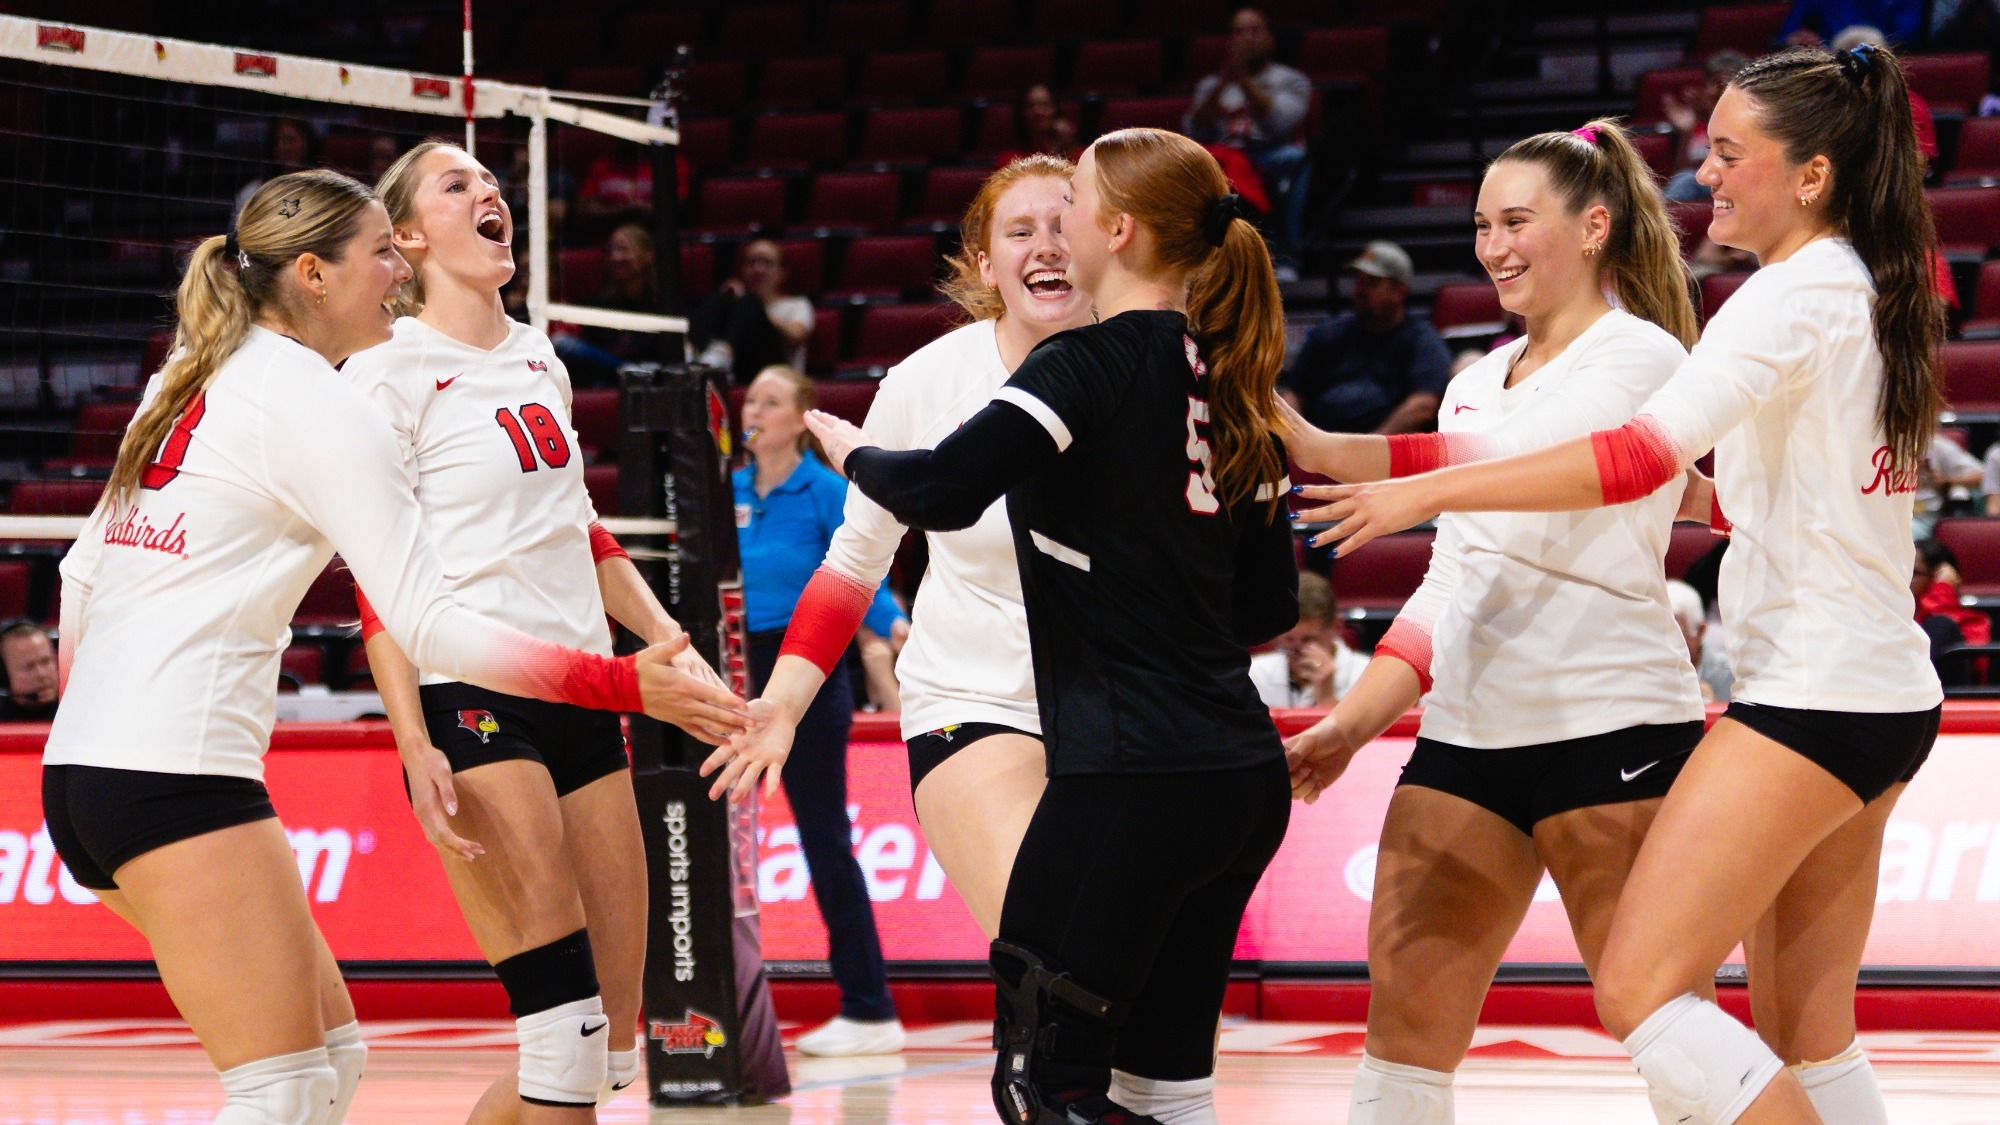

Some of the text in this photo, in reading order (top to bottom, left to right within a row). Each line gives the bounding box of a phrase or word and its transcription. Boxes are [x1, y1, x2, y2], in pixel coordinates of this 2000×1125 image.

[495, 402, 571, 473] 18
[664, 800, 696, 982] sports imports
